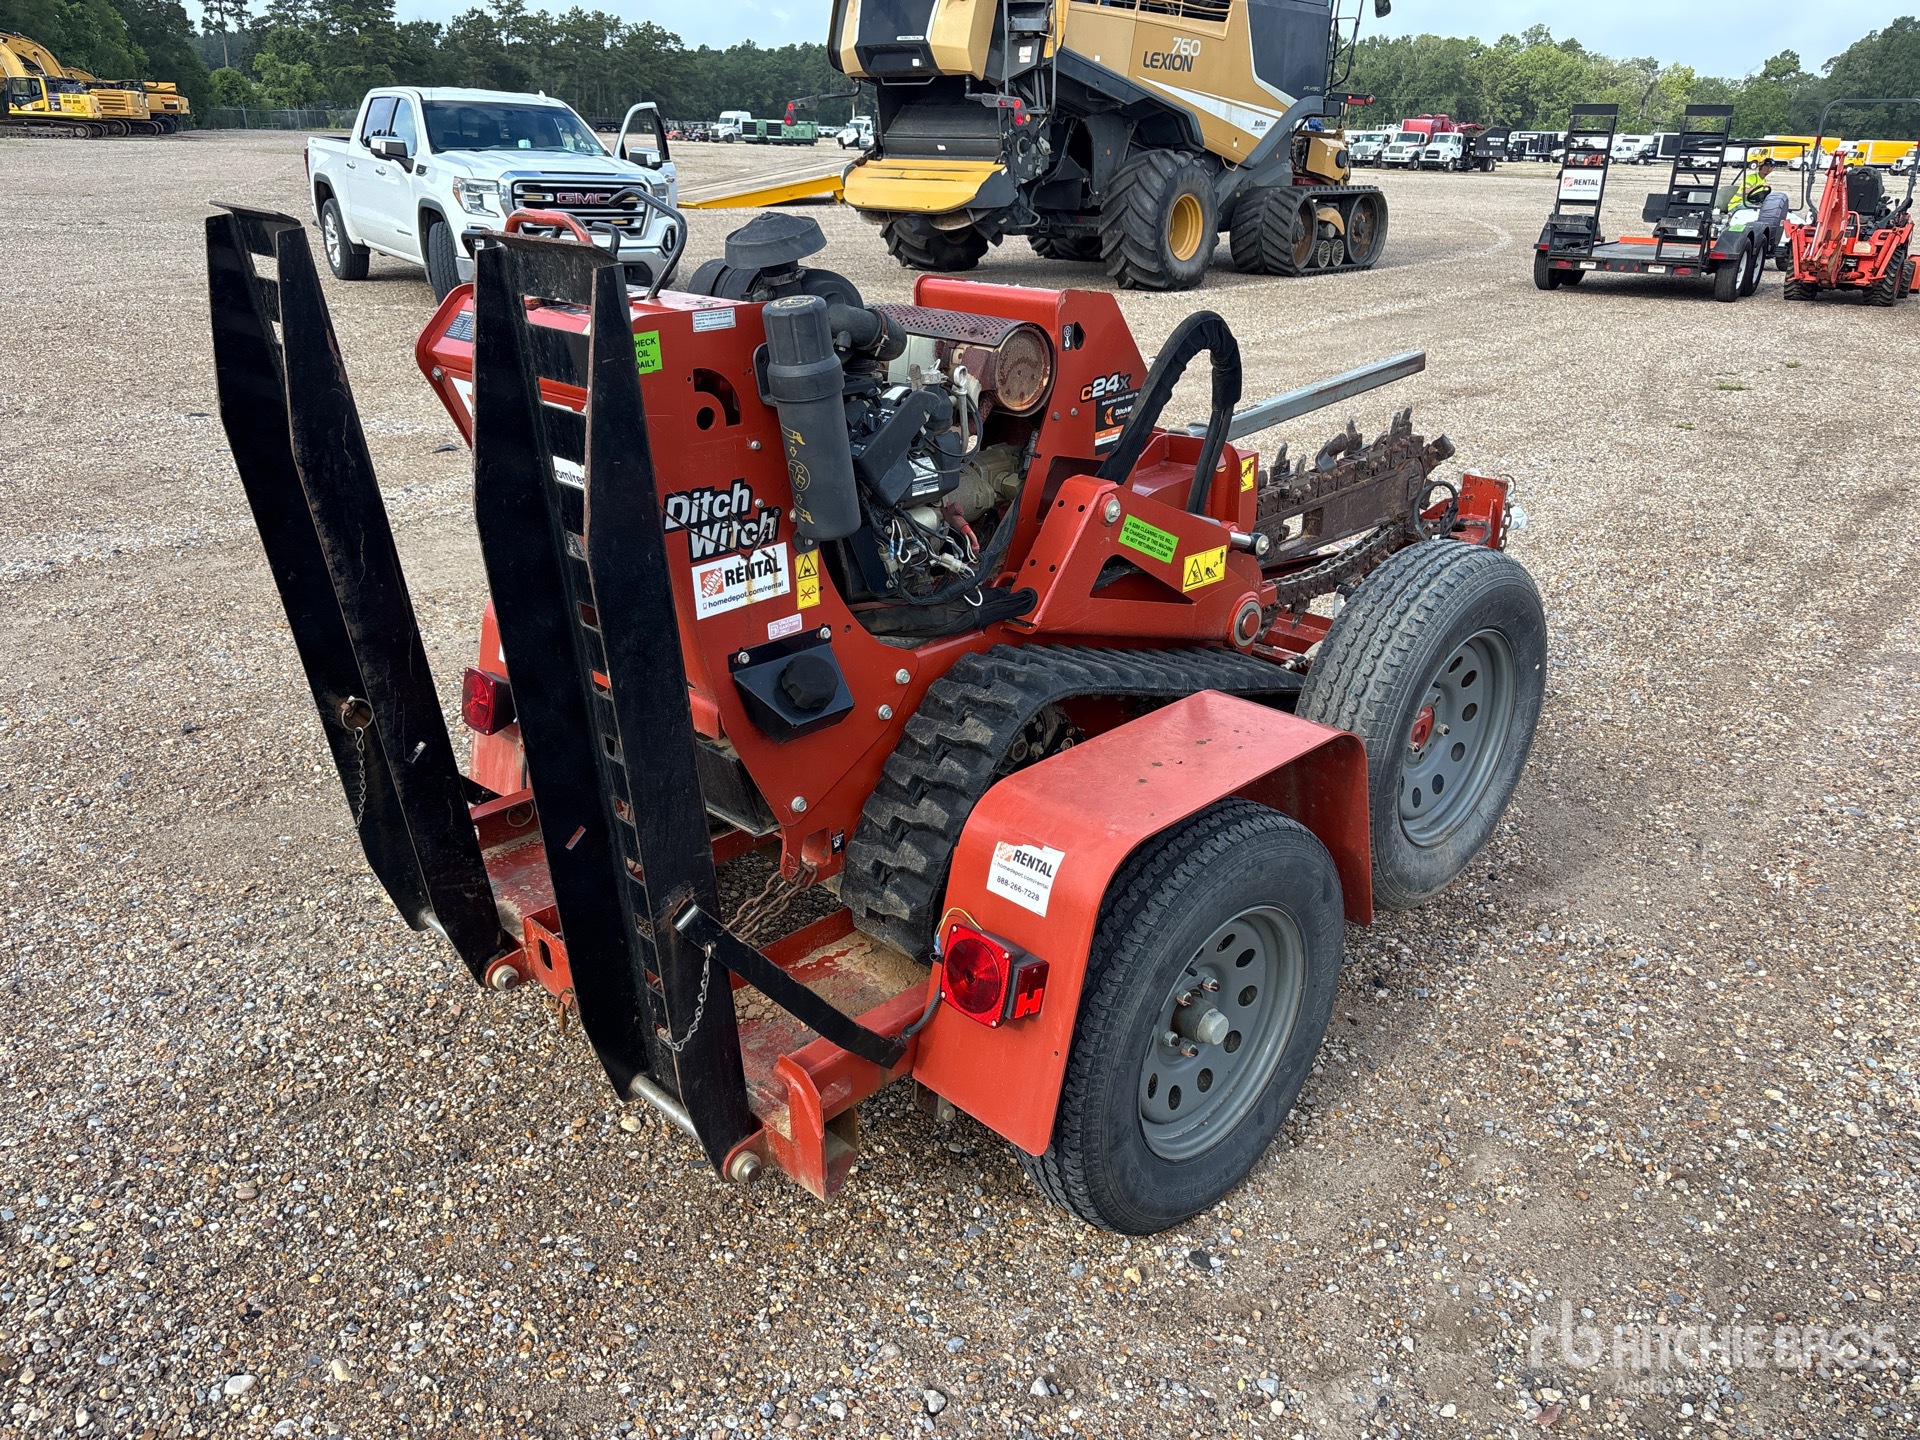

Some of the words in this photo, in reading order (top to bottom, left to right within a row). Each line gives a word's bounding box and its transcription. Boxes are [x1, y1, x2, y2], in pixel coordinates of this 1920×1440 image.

[1171, 36, 1201, 57] 760
[1142, 50, 1194, 72] LEXION
[1573, 178, 1599, 186] RENTAL
[556, 192, 612, 205] GMC
[635, 337, 656, 347] HECK
[637, 350, 650, 358] OIL
[665, 482, 750, 530] Ditch
[690, 511, 775, 559] Witch
[725, 559, 782, 587] RENTAL
[708, 580, 784, 609] homedepot.com/rental
[997, 862, 1050, 890] homedepot.com/rental
[1013, 849, 1053, 878] RENTAL
[996, 876, 1040, 901] 888-266-7228
